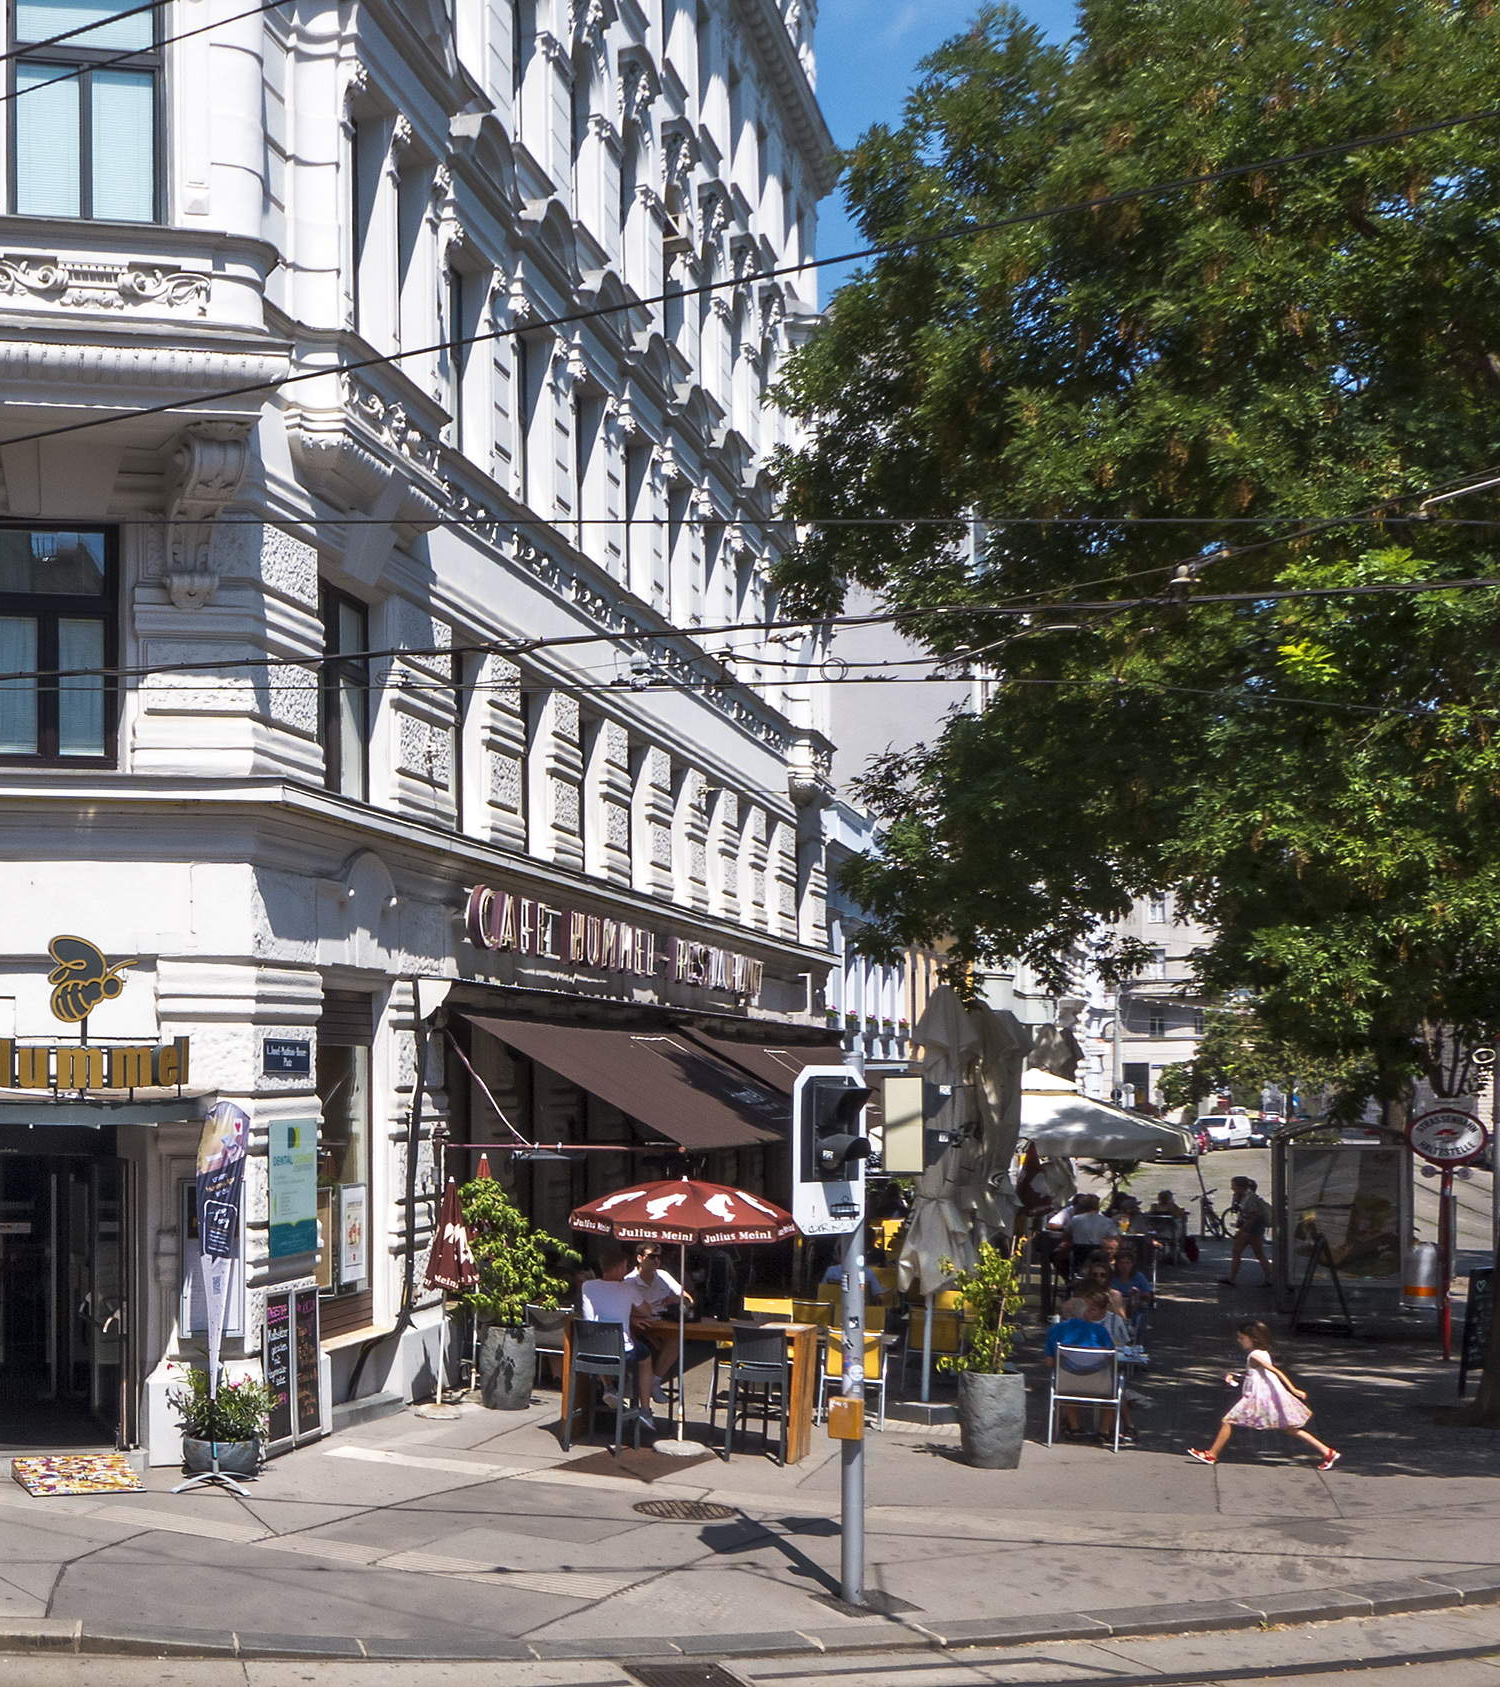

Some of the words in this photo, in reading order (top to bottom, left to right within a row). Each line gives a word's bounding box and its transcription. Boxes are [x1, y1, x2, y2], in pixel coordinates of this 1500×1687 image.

[561, 907, 656, 977] HUMMEL
[1416, 1115, 1479, 1134] STRASSENBAHN
[1419, 1141, 1476, 1157] HALTESTELLE
[619, 1227, 657, 1239] Julius
[661, 1231, 693, 1242] Meinl
[704, 1233, 736, 1244] Julius
[739, 1231, 772, 1240] Meinl
